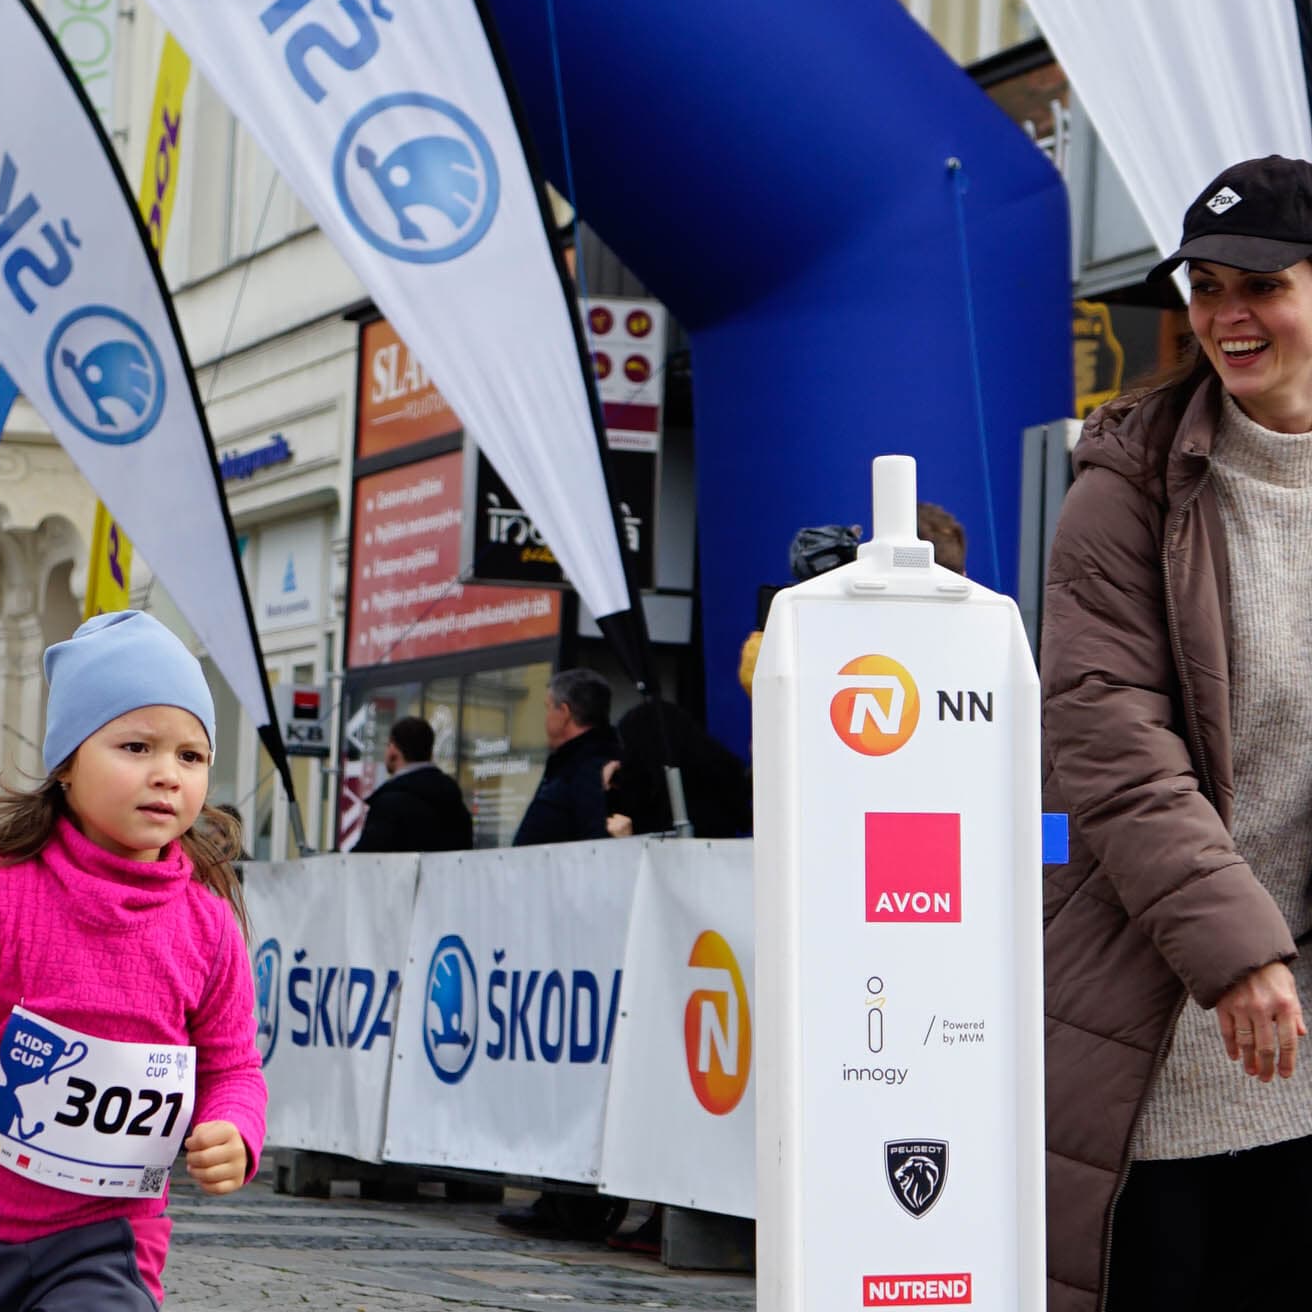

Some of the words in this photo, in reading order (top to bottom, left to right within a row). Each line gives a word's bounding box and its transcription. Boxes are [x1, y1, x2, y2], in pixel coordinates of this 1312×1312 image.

[371, 343, 433, 404] SLA
[936, 690, 994, 722] NN
[875, 892, 952, 913] AVON
[943, 1020, 985, 1030] Powered
[13, 1030, 54, 1056] KIDS
[943, 1033, 955, 1045] by
[959, 1034, 984, 1042] MVM
[9, 1046, 45, 1069] CUP
[148, 1052, 173, 1065] KIDS
[146, 1066, 169, 1078] CUP
[843, 1063, 908, 1085] innogy
[54, 1076, 184, 1138] 3021
[890, 1145, 943, 1155] PEUGEOT
[869, 1279, 968, 1301] NUTREND
